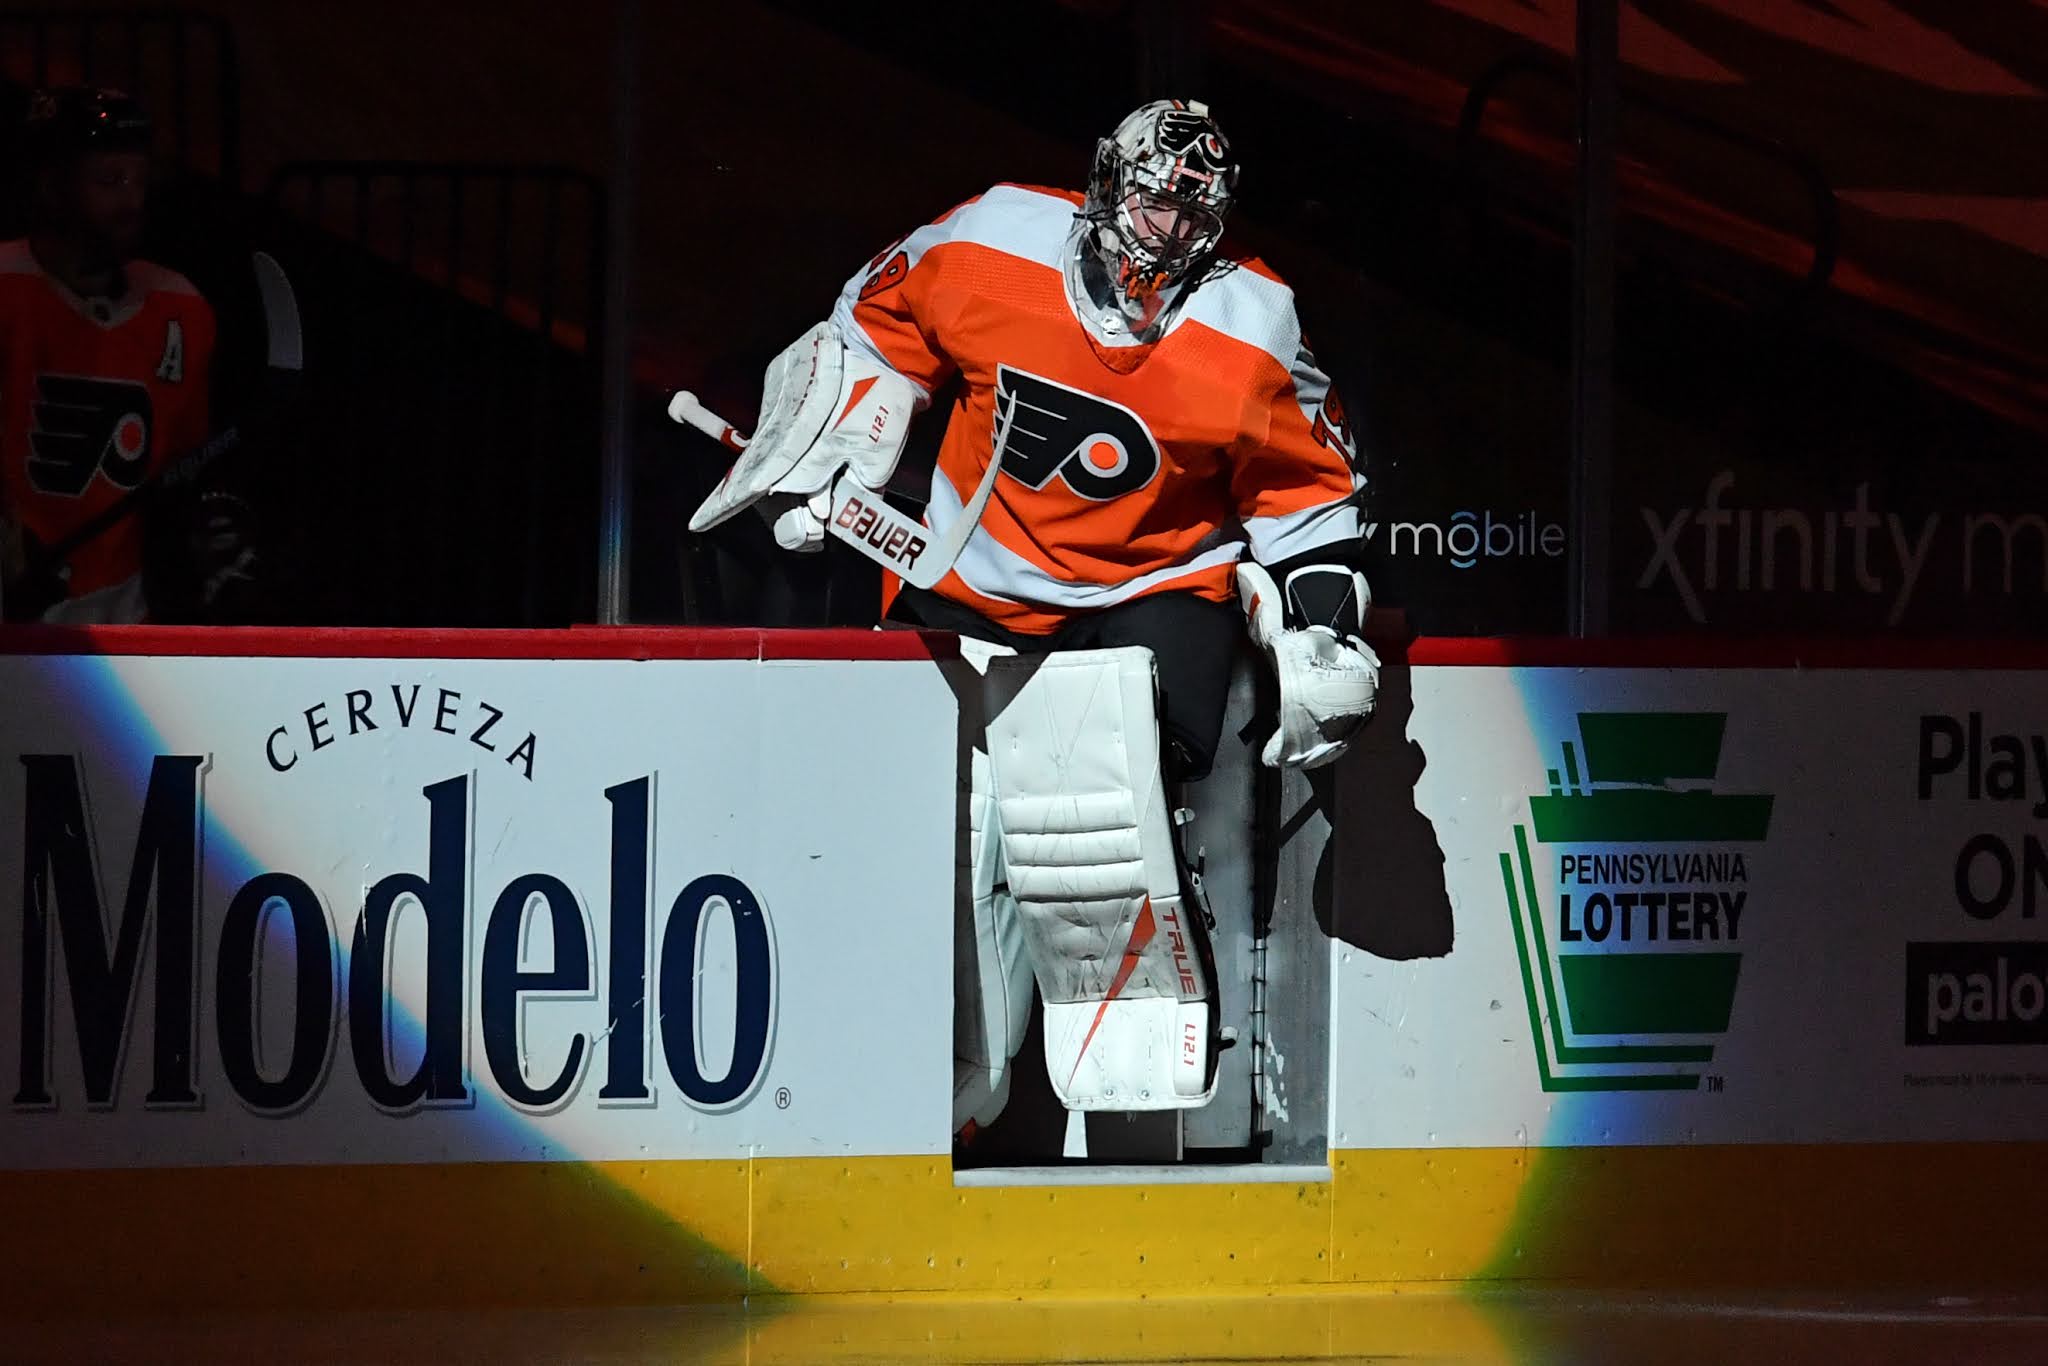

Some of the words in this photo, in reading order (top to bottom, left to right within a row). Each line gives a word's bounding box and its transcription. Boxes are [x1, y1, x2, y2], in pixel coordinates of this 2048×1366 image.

[154, 320, 183, 382] A
[835, 496, 927, 571] BAUER
[1390, 508, 1566, 569] mobile
[1635, 468, 1942, 627] xfinity
[266, 684, 538, 780] CERVEZA
[1560, 854, 1748, 885] PENNSYLVANIA
[12, 754, 778, 1116] Modelo
[1162, 907, 1197, 995] TRUE
[1560, 891, 1748, 942] LOTTERY
[1927, 954, 2048, 1036] palo
